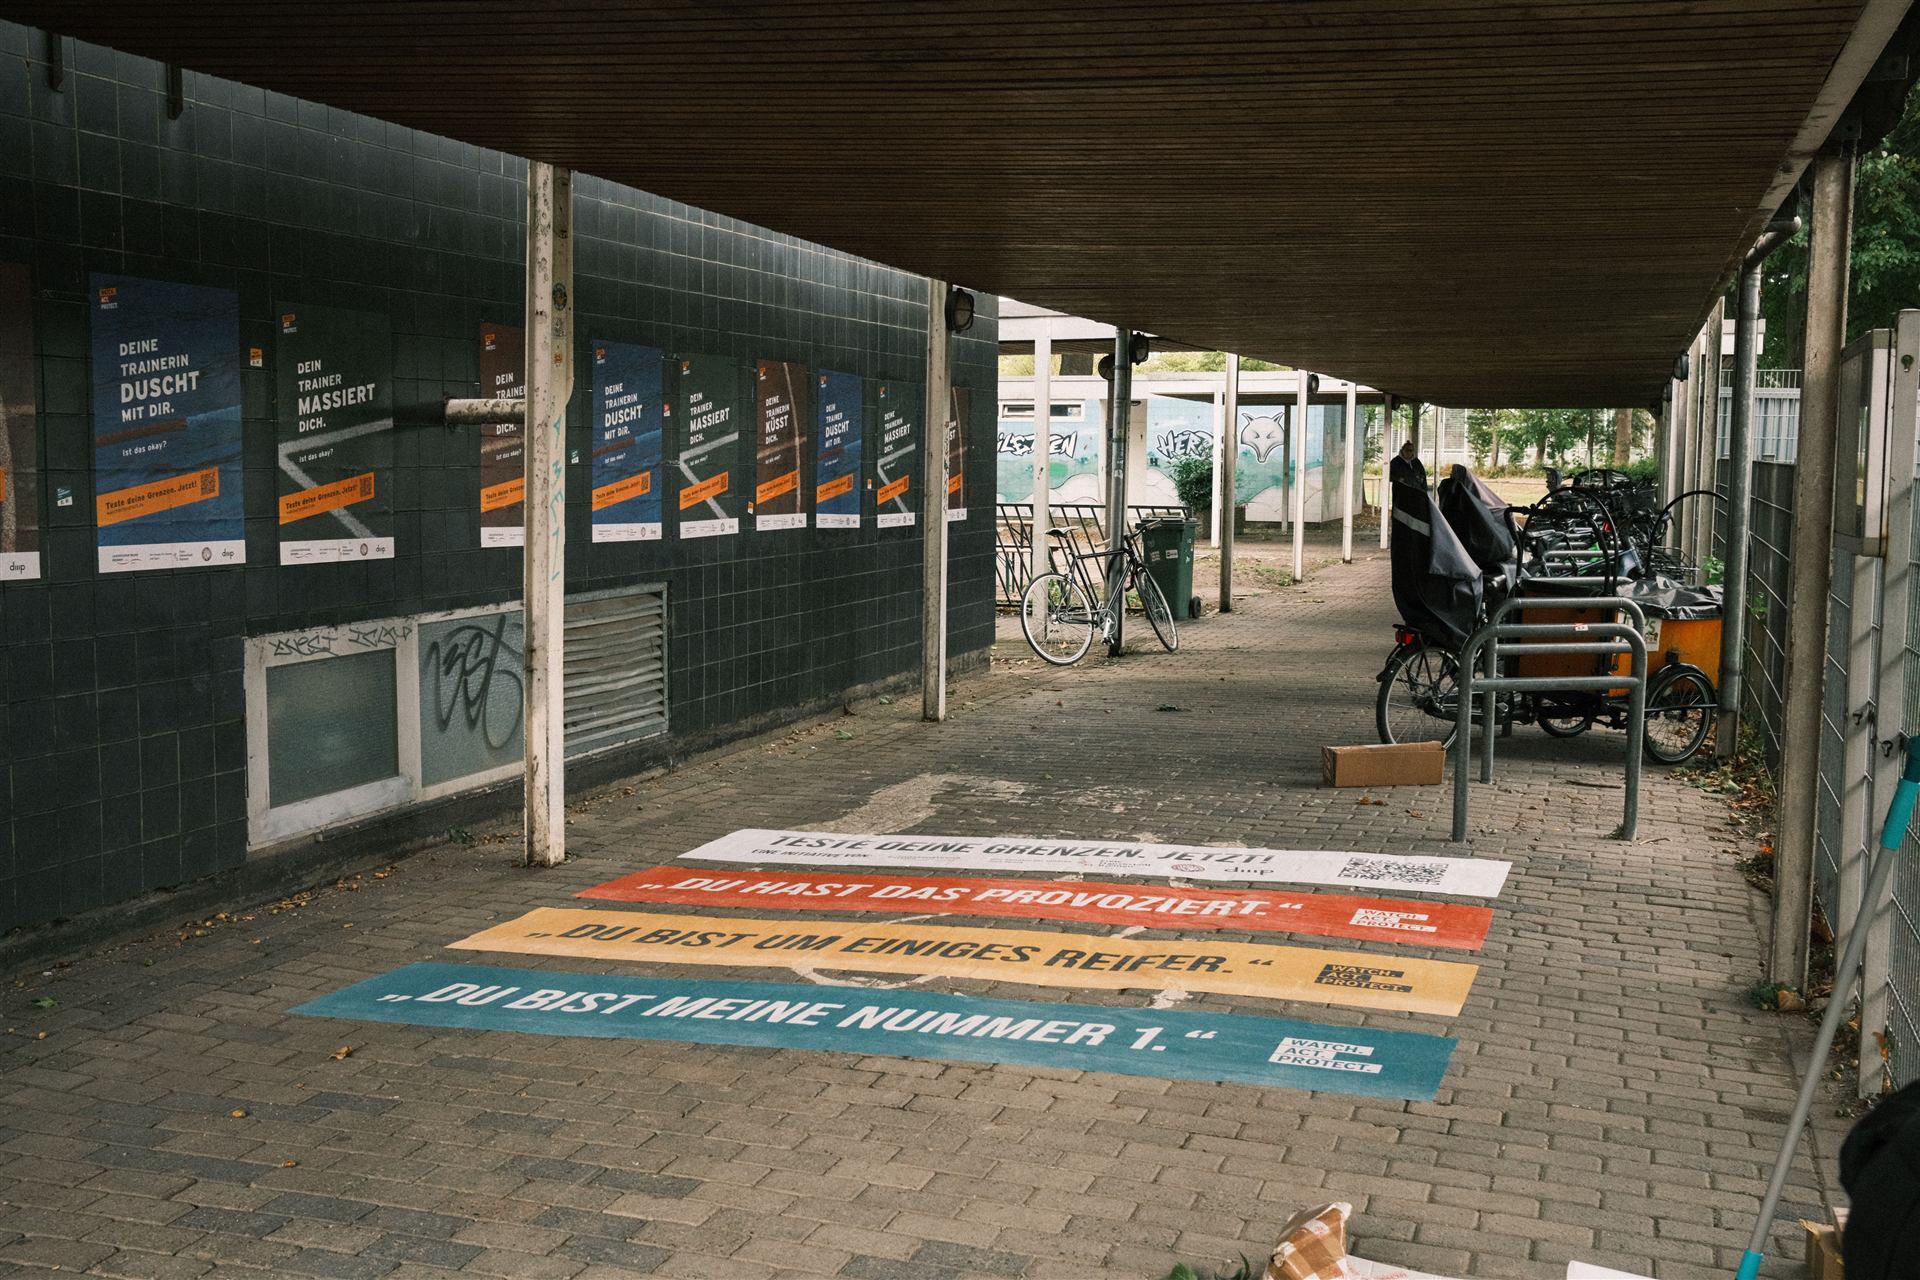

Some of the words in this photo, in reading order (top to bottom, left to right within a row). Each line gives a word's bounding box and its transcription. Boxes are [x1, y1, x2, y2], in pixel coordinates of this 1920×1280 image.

[119, 339, 159, 357] DEINE
[120, 354, 189, 377] TRAINERIN
[297, 360, 322, 374] DEIN
[120, 370, 200, 403] DUSCHT
[298, 374, 342, 392] TRAINER
[495, 372, 514, 385] DEIN
[496, 385, 526, 400] TRAINE
[604, 383, 623, 396] DEINE
[298, 383, 376, 416] MASSIERT
[604, 393, 638, 409] TRAINERIN
[689, 392, 703, 404] DEIN
[765, 395, 780, 407] DEINE
[121, 406, 145, 423] MIT
[149, 401, 175, 417] DIR.
[604, 404, 643, 428] DUSCHT
[690, 401, 713, 416] TRAINER
[765, 403, 790, 418] TRAINERIN
[299, 417, 327, 433] DICH.
[690, 407, 730, 433] MASSIERT
[765, 414, 789, 434] KÜSST
[496, 423, 517, 435] DICH.
[604, 429, 617, 440] MIT
[617, 425, 631, 437] DIR.
[825, 420, 850, 438] DUSCHT
[884, 423, 911, 444] MASSIERT
[134, 446, 146, 454] das
[147, 440, 167, 452] okay?
[690, 433, 705, 445] DICH.
[308, 453, 317, 461] das
[318, 448, 334, 458] okay?
[105, 500, 125, 510] Teste
[127, 494, 145, 503] deine
[769, 836, 875, 849] TESTE
[874, 842, 983, 853] DEINE
[983, 844, 1145, 859] GRENZEN.
[1157, 851, 1276, 864] JETZT!
[738, 880, 875, 897] HAST
[868, 885, 971, 901] DAS
[631, 928, 759, 948] BIST
[753, 934, 844, 953] UM
[840, 936, 1041, 963] EINIGES
[1321, 978, 1405, 992] PROTECT.
[502, 986, 657, 1014] BIST
[642, 994, 847, 1026] MEINE
[837, 1005, 1117, 1046] NUMMER
[1283, 1047, 1326, 1058] ACT.
[1290, 1039, 1365, 1054] WATCH.
[1277, 1055, 1372, 1072] PROTECT.
